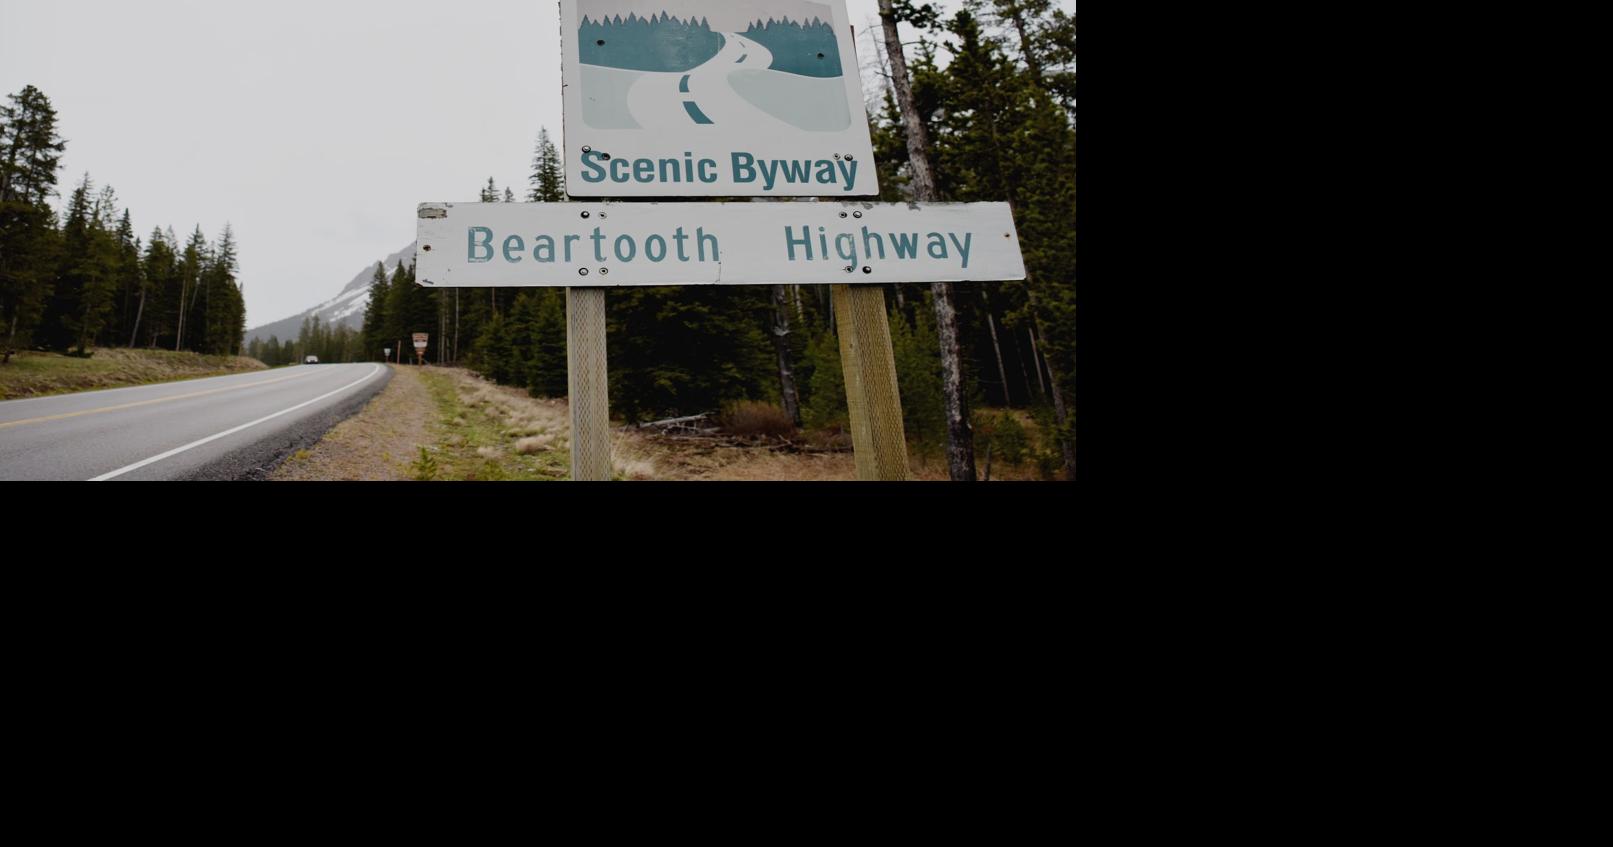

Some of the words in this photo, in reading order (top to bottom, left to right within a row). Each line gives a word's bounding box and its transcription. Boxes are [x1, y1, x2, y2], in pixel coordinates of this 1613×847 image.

[581, 150, 718, 183] Scenic
[731, 151, 858, 192] Byway
[467, 226, 720, 263] Beartooth
[785, 225, 972, 269] Highway
